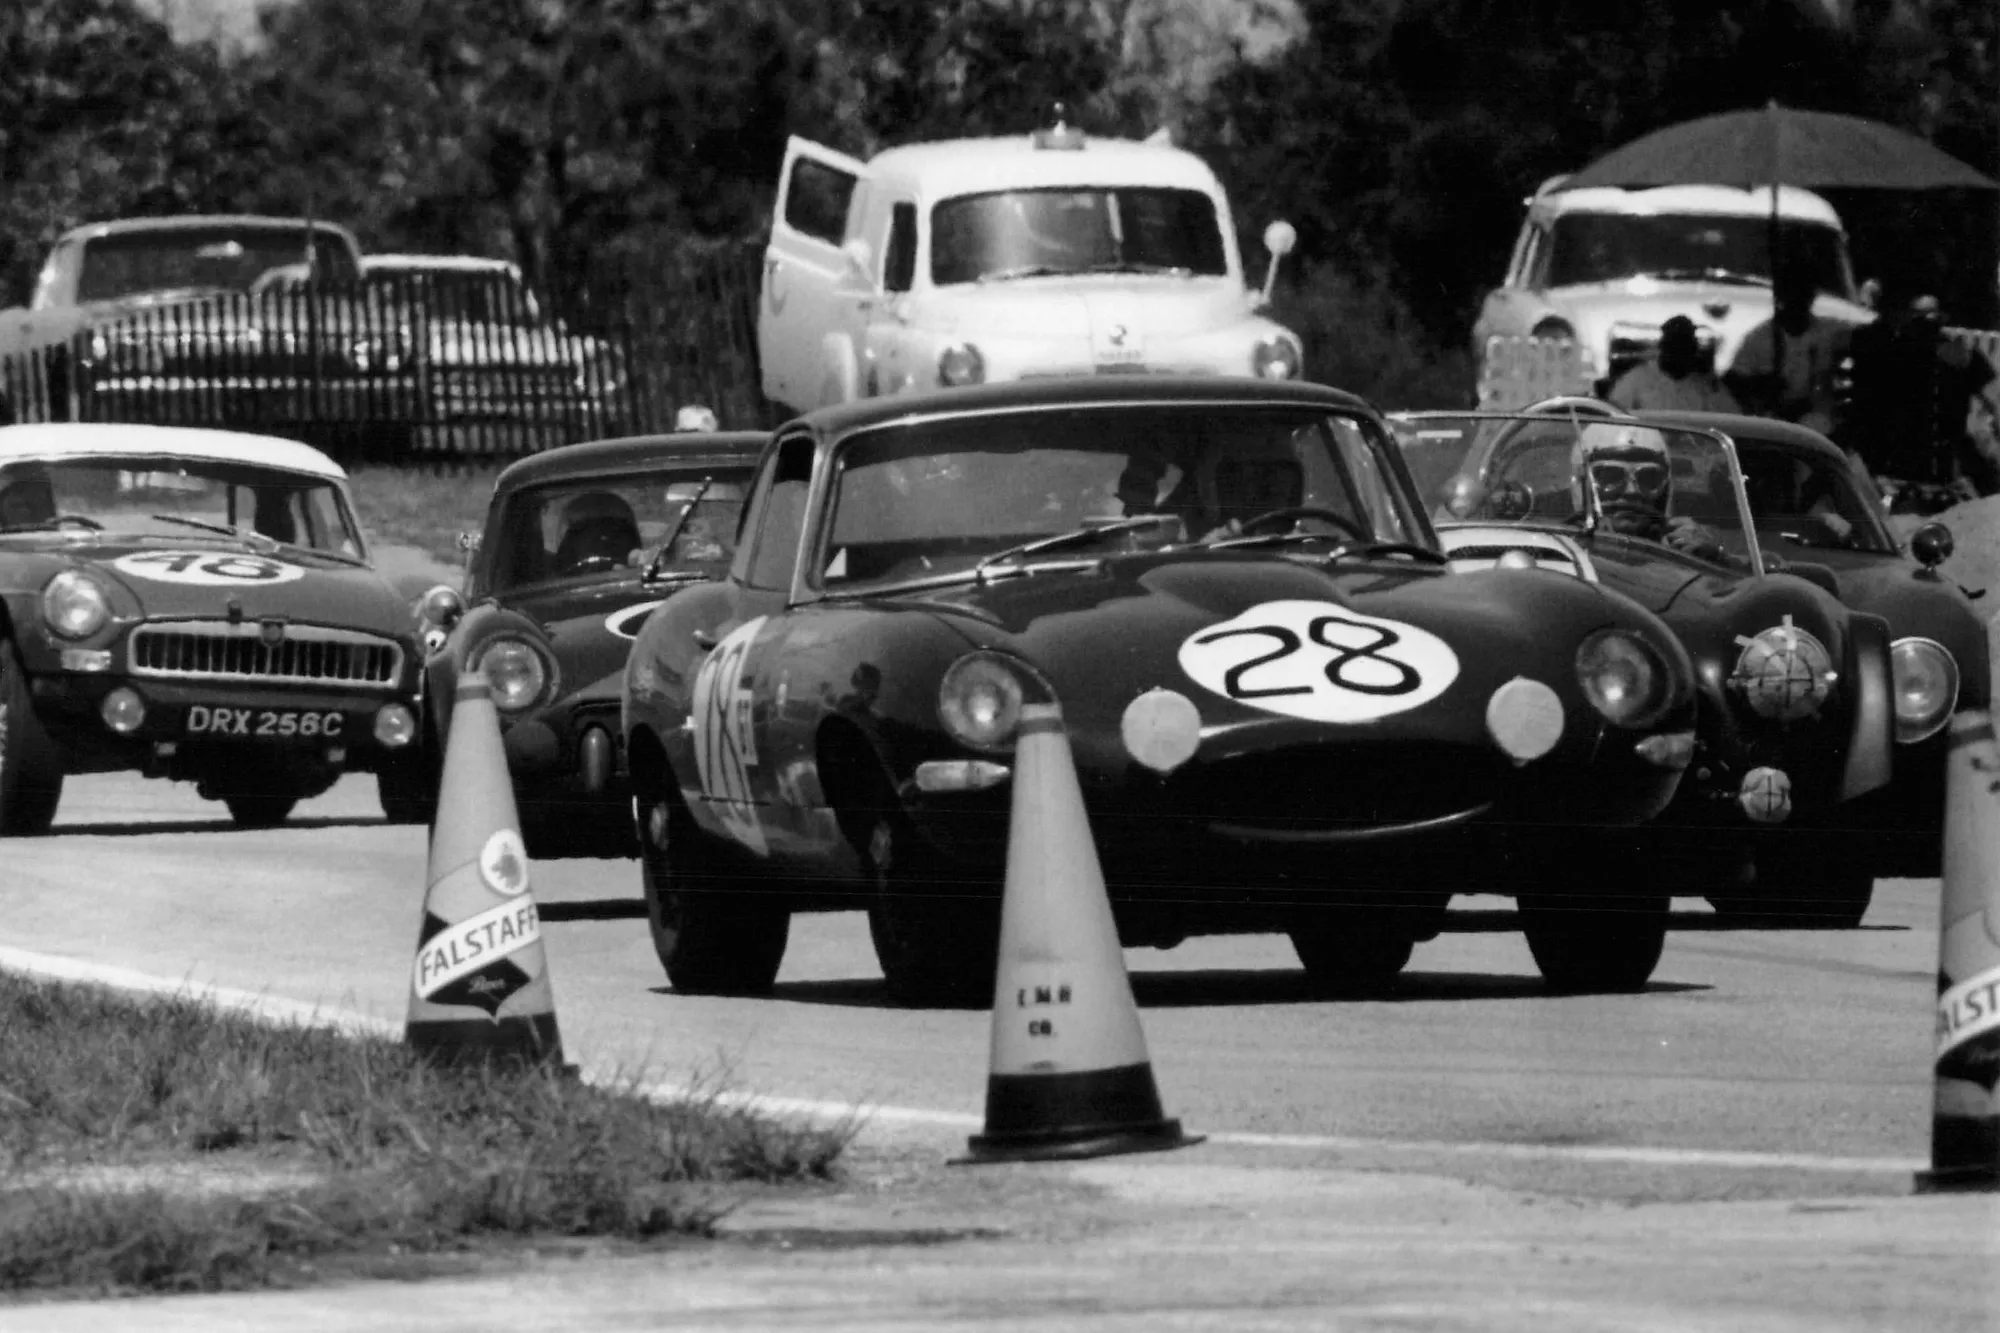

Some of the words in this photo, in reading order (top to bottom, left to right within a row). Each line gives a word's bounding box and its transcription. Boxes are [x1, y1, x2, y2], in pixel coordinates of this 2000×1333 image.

[1195, 616, 1422, 699] 28
[188, 706, 252, 734] DRX
[256, 711, 343, 736] 256C
[419, 903, 538, 986] FALSTAFF
